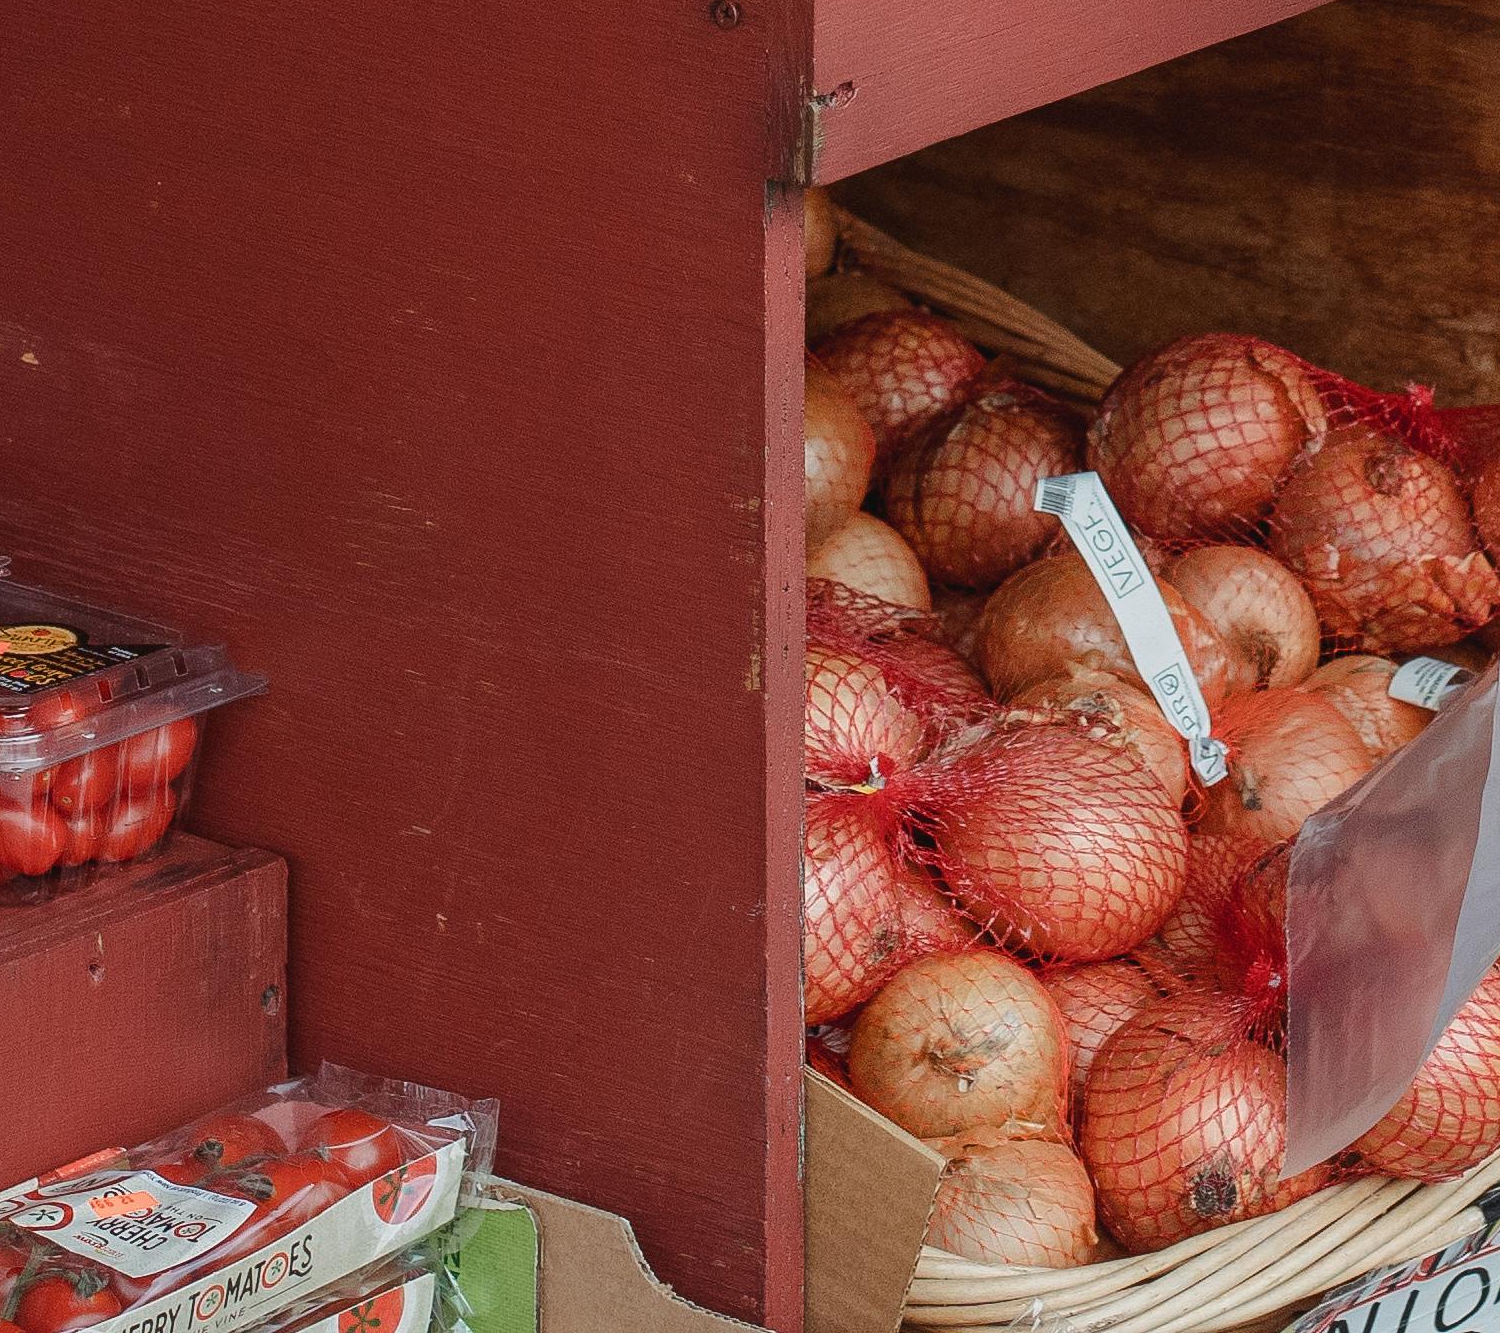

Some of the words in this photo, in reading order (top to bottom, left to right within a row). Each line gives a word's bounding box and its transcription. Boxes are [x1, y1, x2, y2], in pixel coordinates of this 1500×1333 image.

[187, 1213, 204, 1221] ON
[86, 1217, 169, 1252] CHERRY
[187, 1234, 314, 1331] TOMATOES
[215, 1306, 247, 1328] VINE
